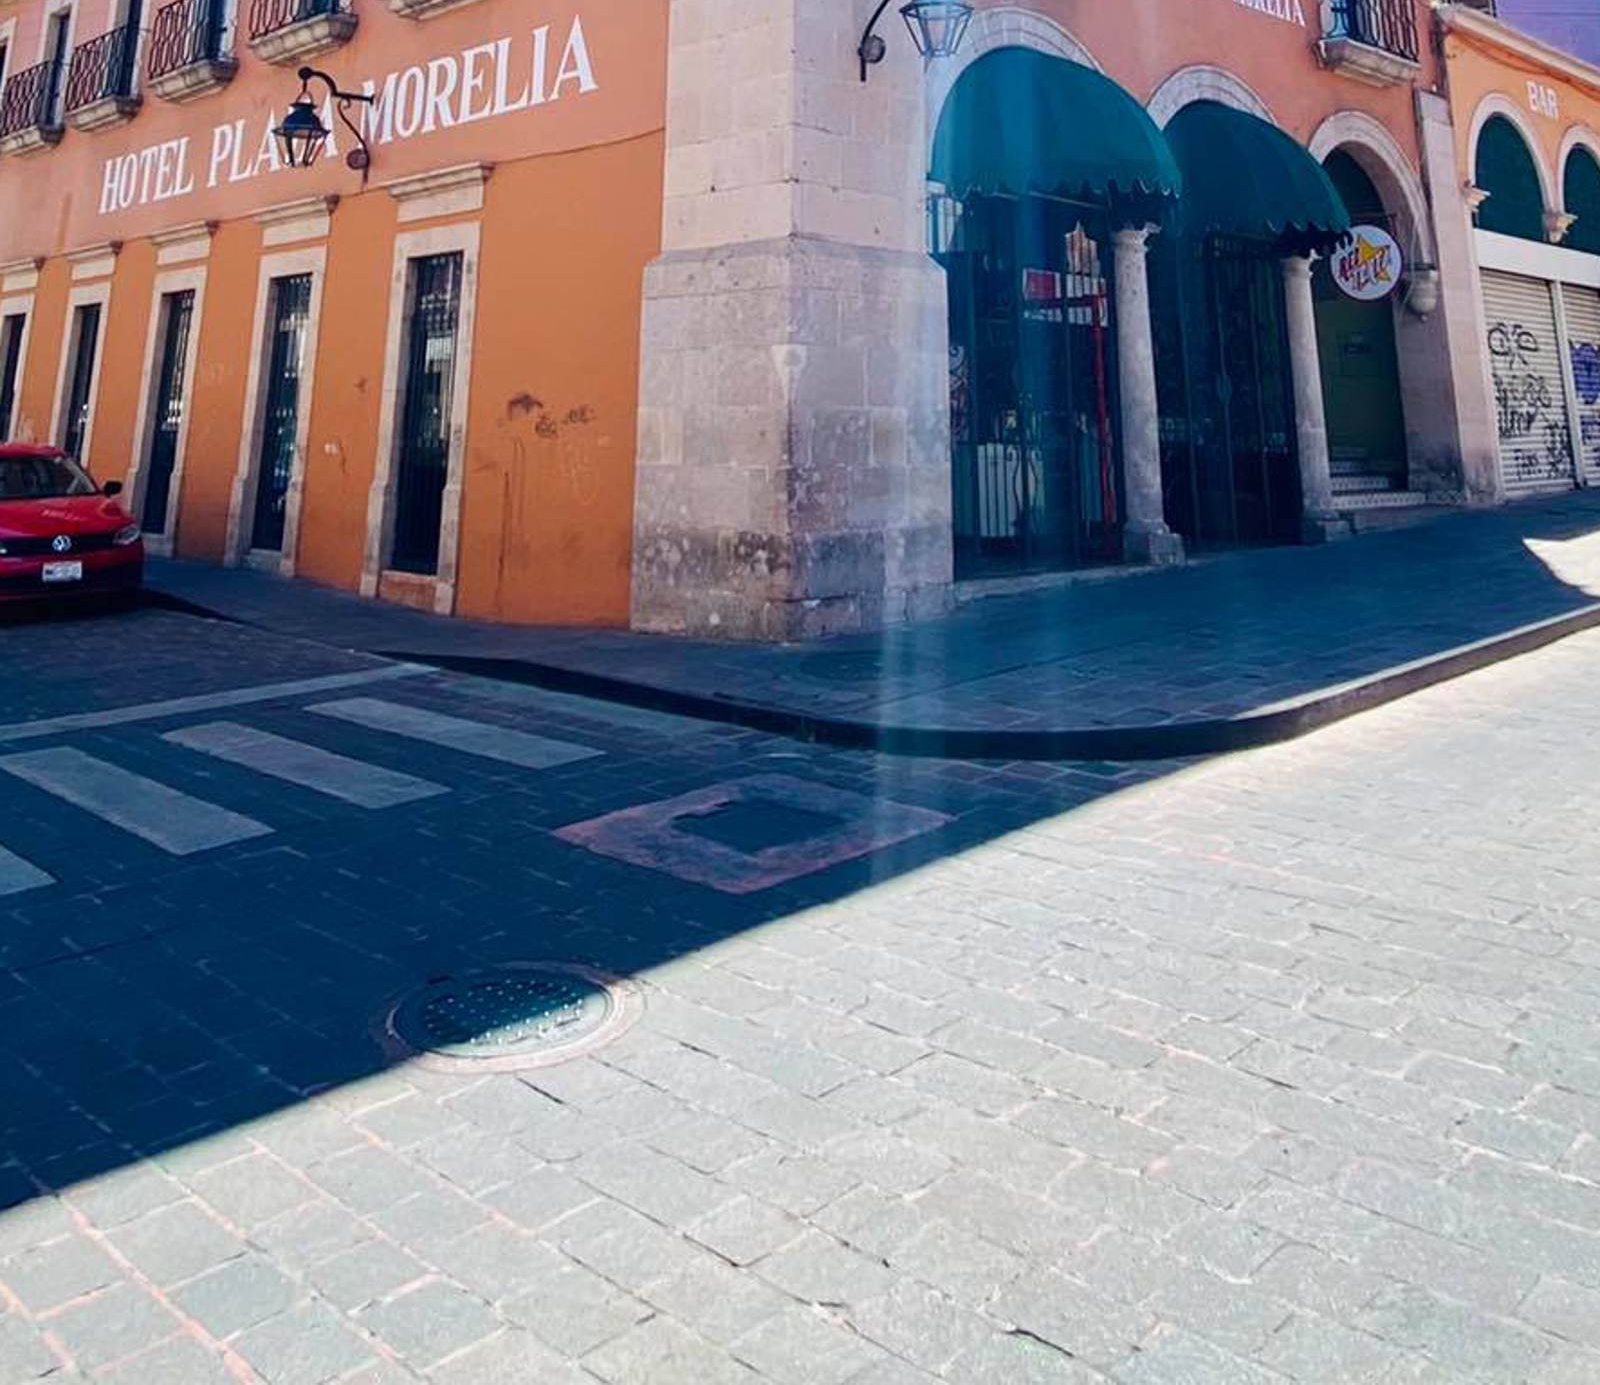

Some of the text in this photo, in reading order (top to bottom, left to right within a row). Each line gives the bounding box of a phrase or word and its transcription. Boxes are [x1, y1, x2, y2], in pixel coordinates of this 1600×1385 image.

[98, 14, 599, 214] HOTEL PLAA MORELIA
[1526, 80, 1559, 120] BAR
